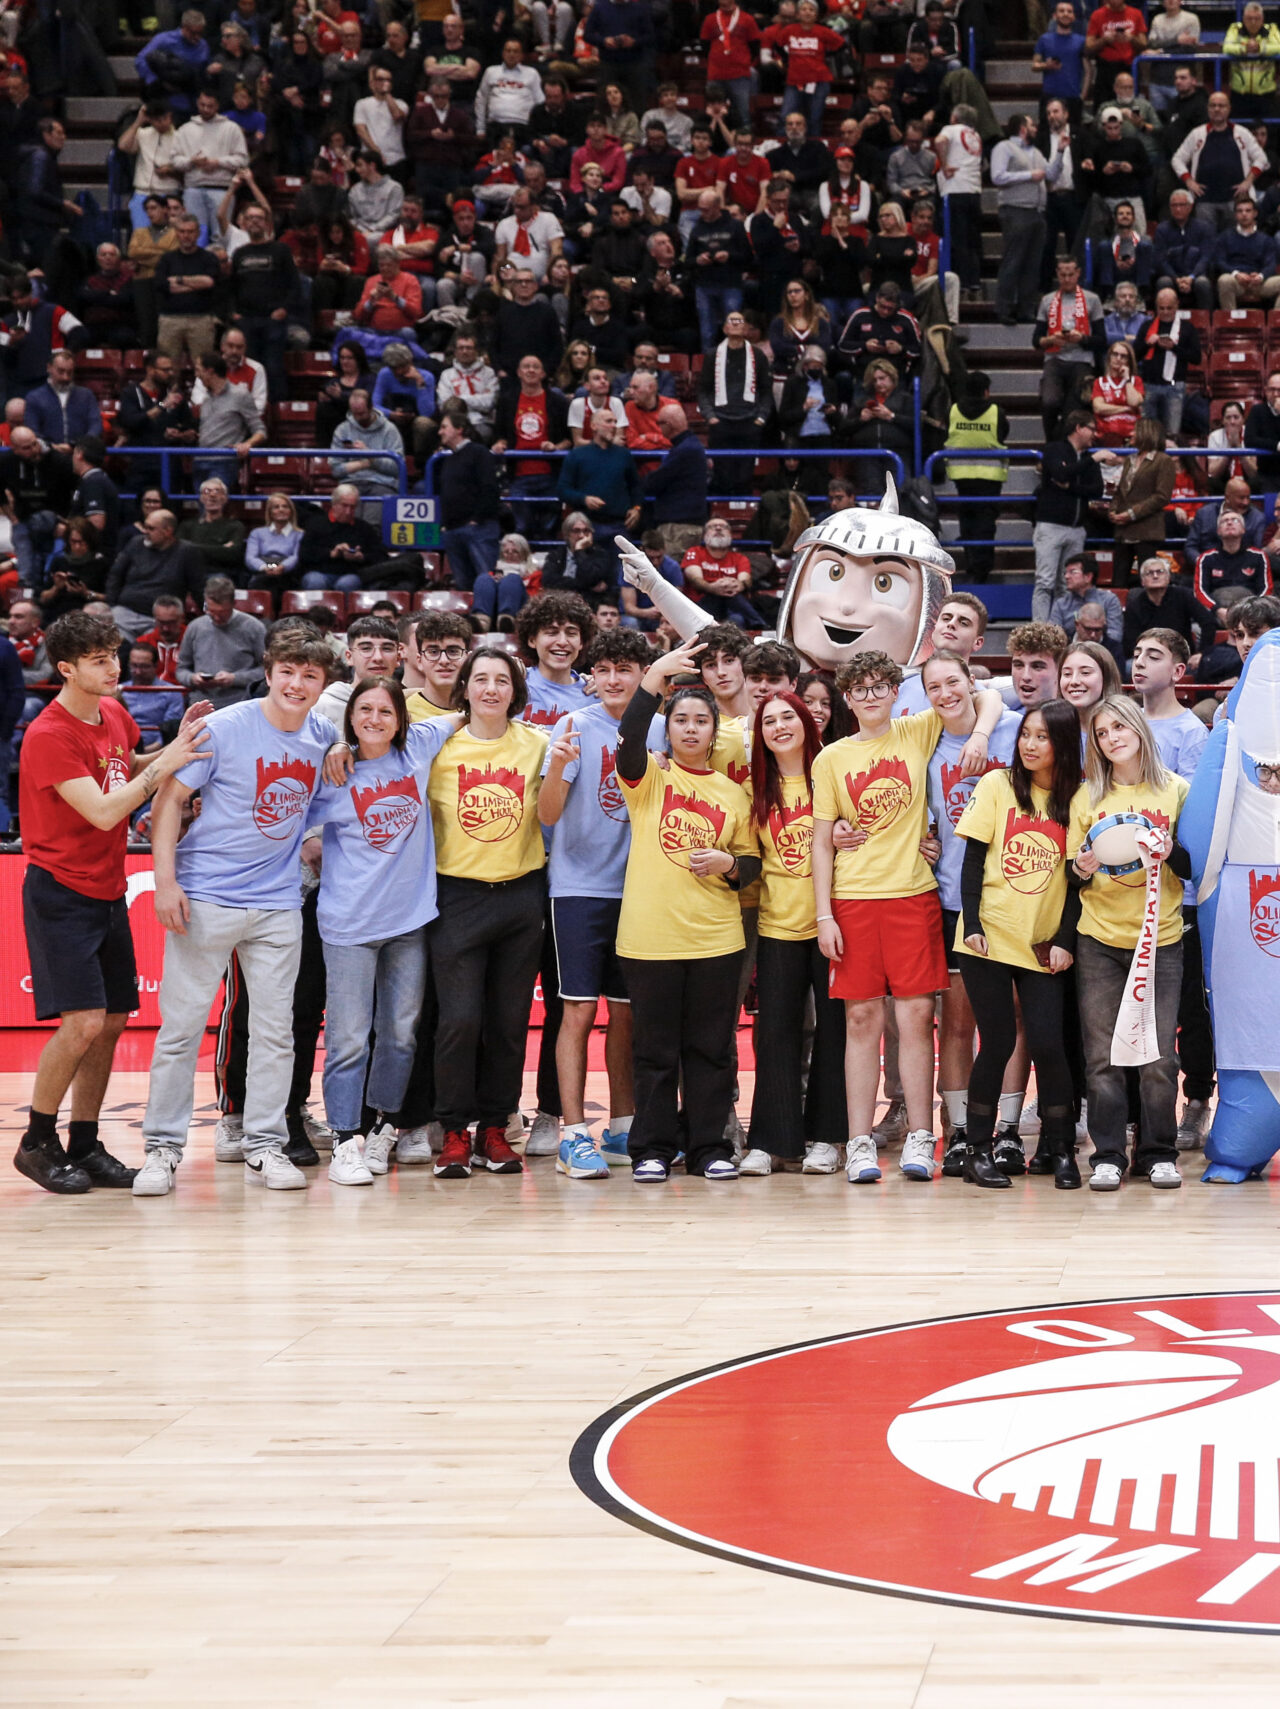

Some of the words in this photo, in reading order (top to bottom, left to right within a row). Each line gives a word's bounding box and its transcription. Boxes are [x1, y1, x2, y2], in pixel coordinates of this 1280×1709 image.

[403, 502, 429, 519] 20
[463, 794, 510, 808] OLIMPIA
[366, 806, 411, 828] OLIMPIA
[462, 806, 513, 827] SCHOOL
[665, 814, 707, 839] OLIMPIA
[368, 812, 414, 845] SCHOOL
[1007, 840, 1052, 861] OLIMPIA
[1003, 856, 1052, 875] SCHOOL
